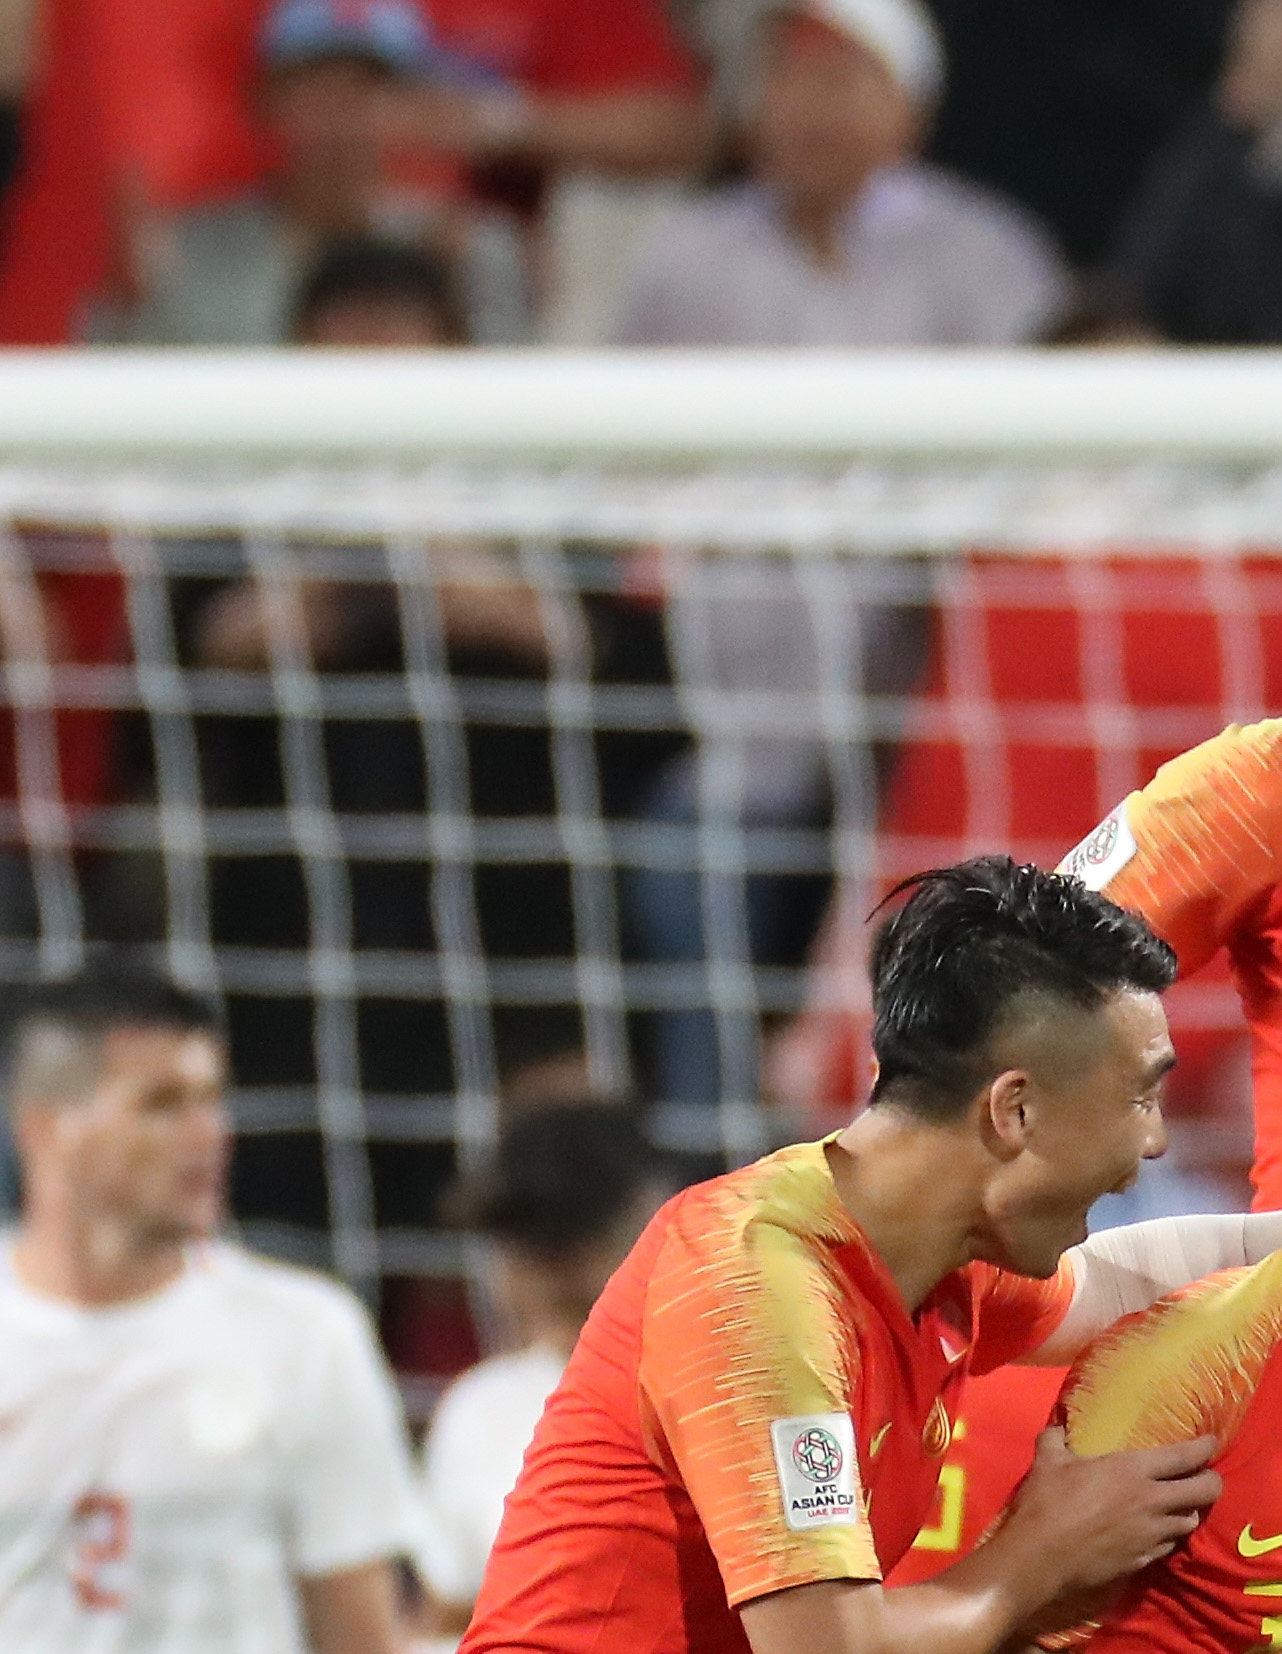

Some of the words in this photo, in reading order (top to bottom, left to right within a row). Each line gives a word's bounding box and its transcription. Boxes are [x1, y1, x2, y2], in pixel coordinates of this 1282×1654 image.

[815, 1485, 837, 1494] AFC
[792, 1495, 835, 1510] ASIAN
[68, 1490, 132, 1611] 2
